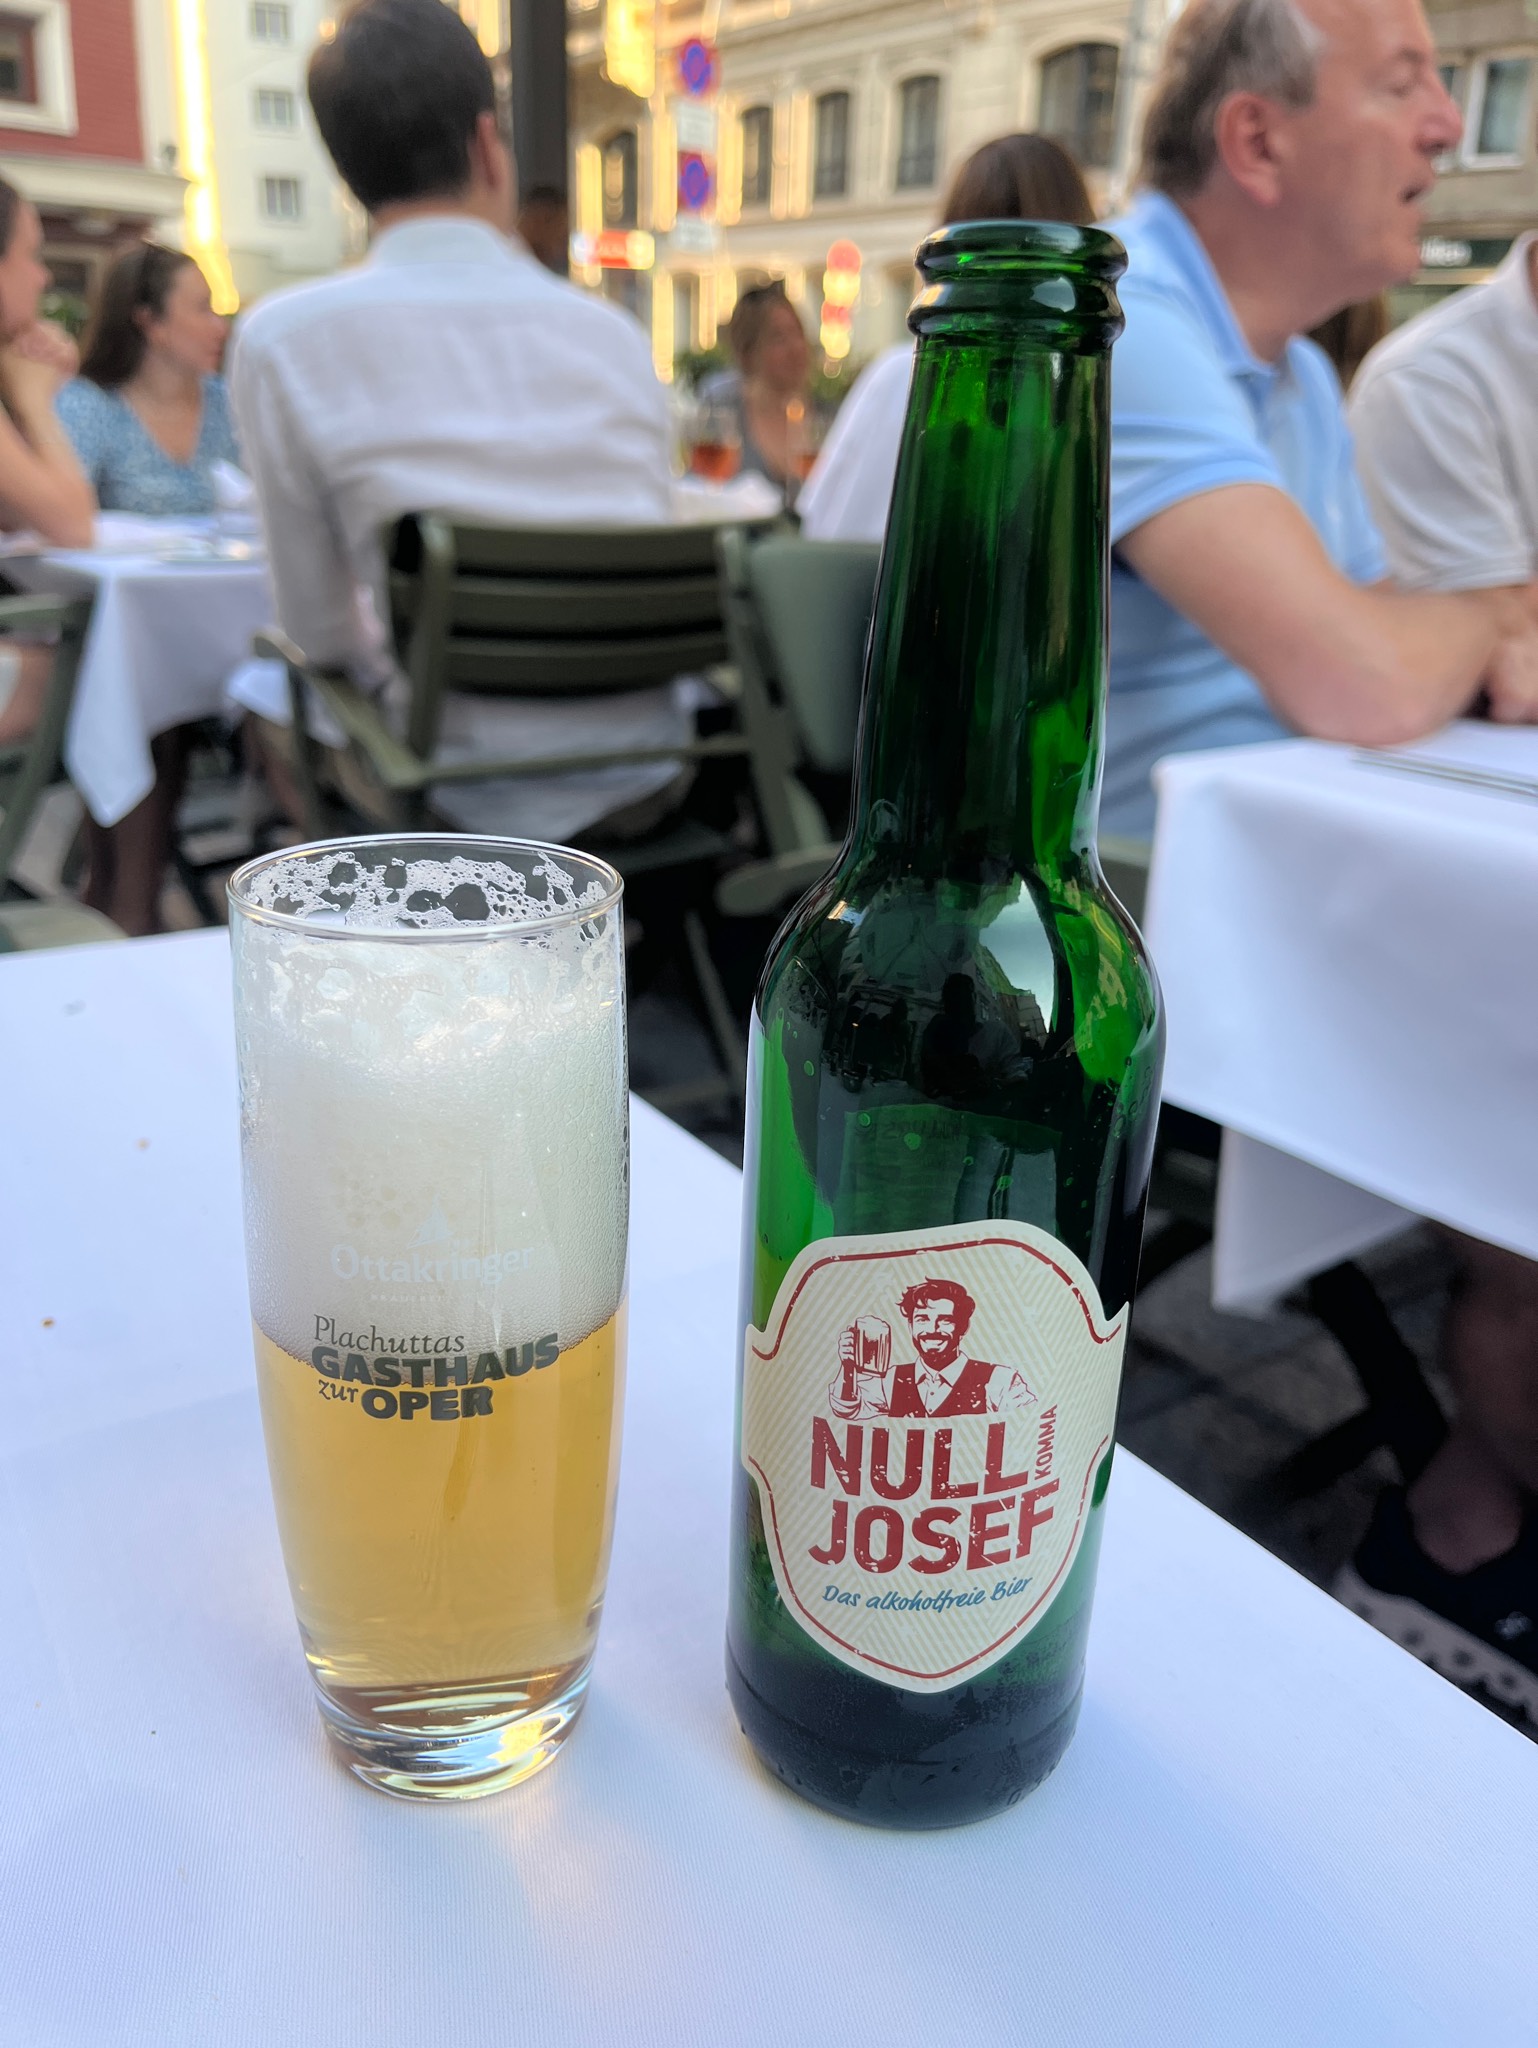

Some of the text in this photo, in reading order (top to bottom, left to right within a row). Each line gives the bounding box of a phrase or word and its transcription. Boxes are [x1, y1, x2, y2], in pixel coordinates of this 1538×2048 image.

[330, 1243, 535, 1285] Ottakringer
[313, 1314, 465, 1354] Plachuttas
[311, 1332, 560, 1388] GASTHAUS
[318, 1379, 494, 1421] zur OPER
[810, 1415, 1029, 1500] NULL
[1034, 1404, 1058, 1481] KOMMA
[808, 1478, 1060, 1575] JOSEF
[822, 1576, 1033, 1613] Das alkoholfreie Bier
